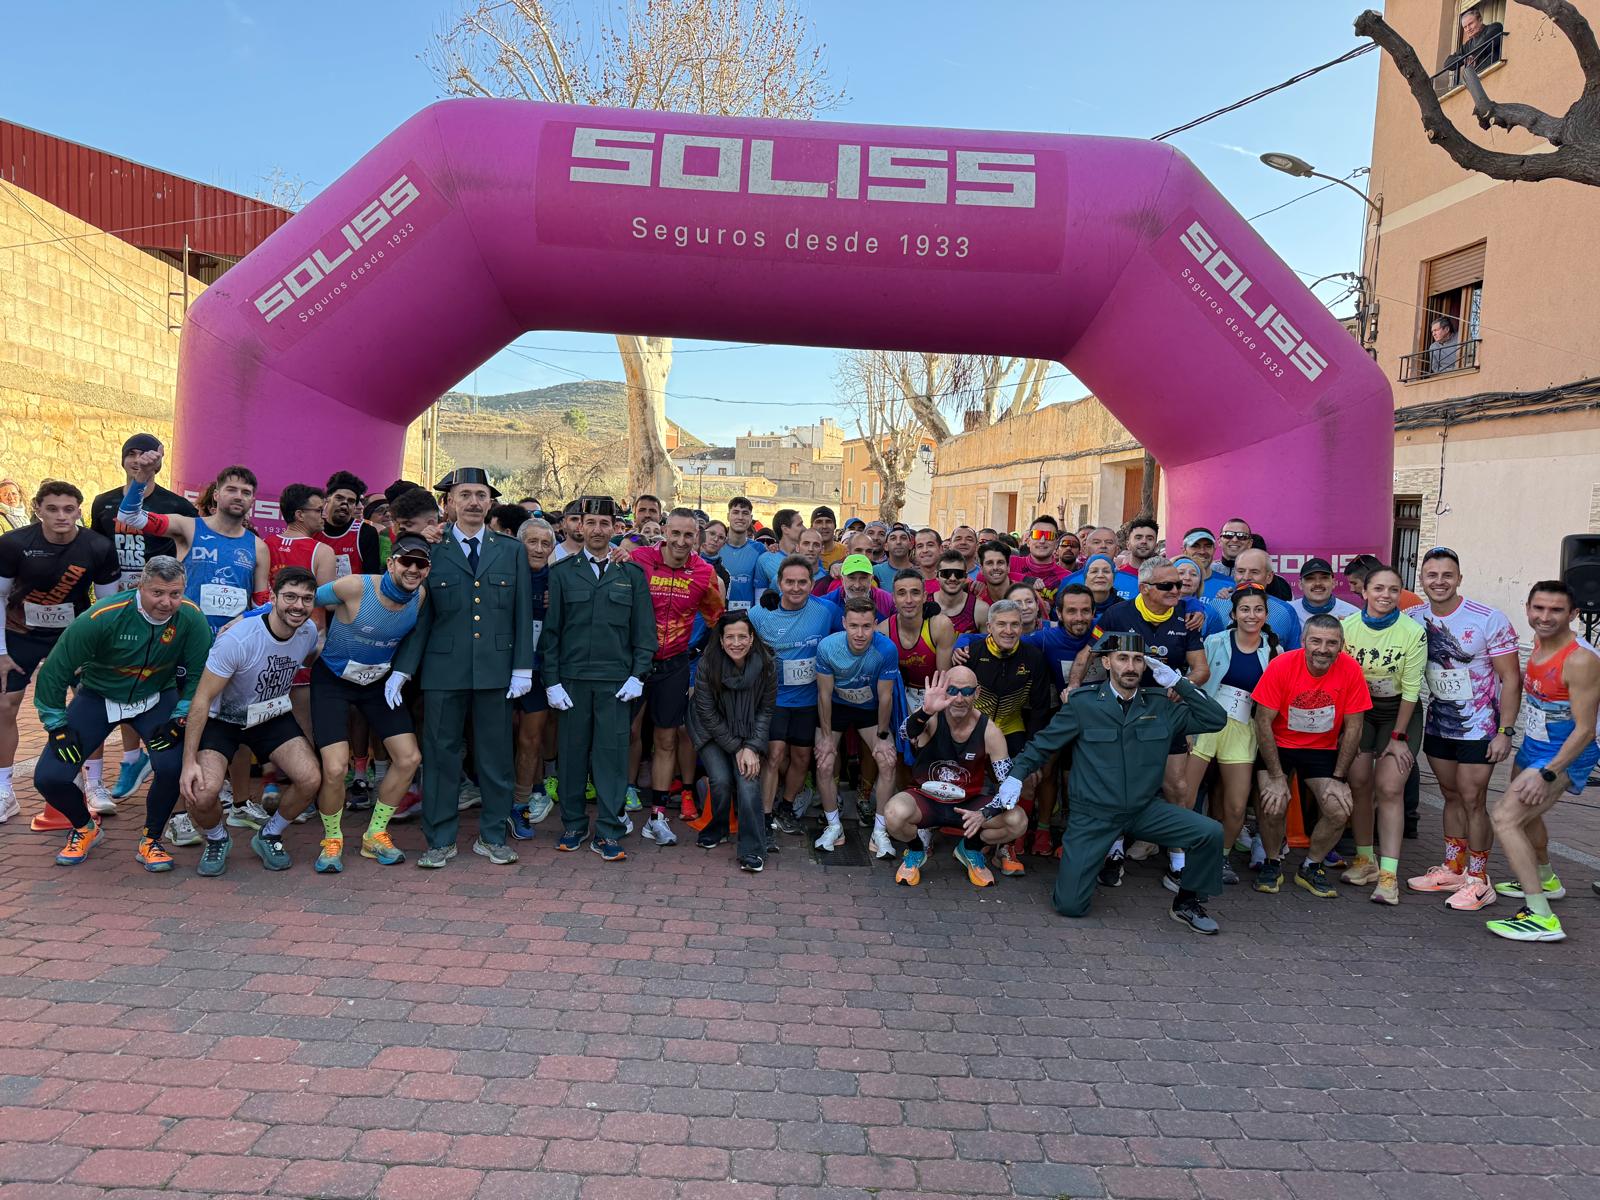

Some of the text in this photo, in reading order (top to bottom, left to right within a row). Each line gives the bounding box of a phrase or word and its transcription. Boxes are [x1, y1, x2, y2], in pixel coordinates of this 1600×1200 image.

[570, 127, 1036, 208] SOLISS
[254, 174, 420, 323] SOLISS
[632, 217, 969, 257] Seguros desde 1933
[298, 223, 415, 322] Seguros desde 1933
[1179, 221, 1329, 382] SOLISS
[1181, 268, 1284, 378] Seguros desde 1933
[115, 534, 145, 550] PAS
[192, 547, 218, 562] DM
[212, 595, 239, 608] 1027
[36, 611, 66, 621] 1076
[792, 667, 816, 679] 1055
[1435, 680, 1461, 692] 1033
